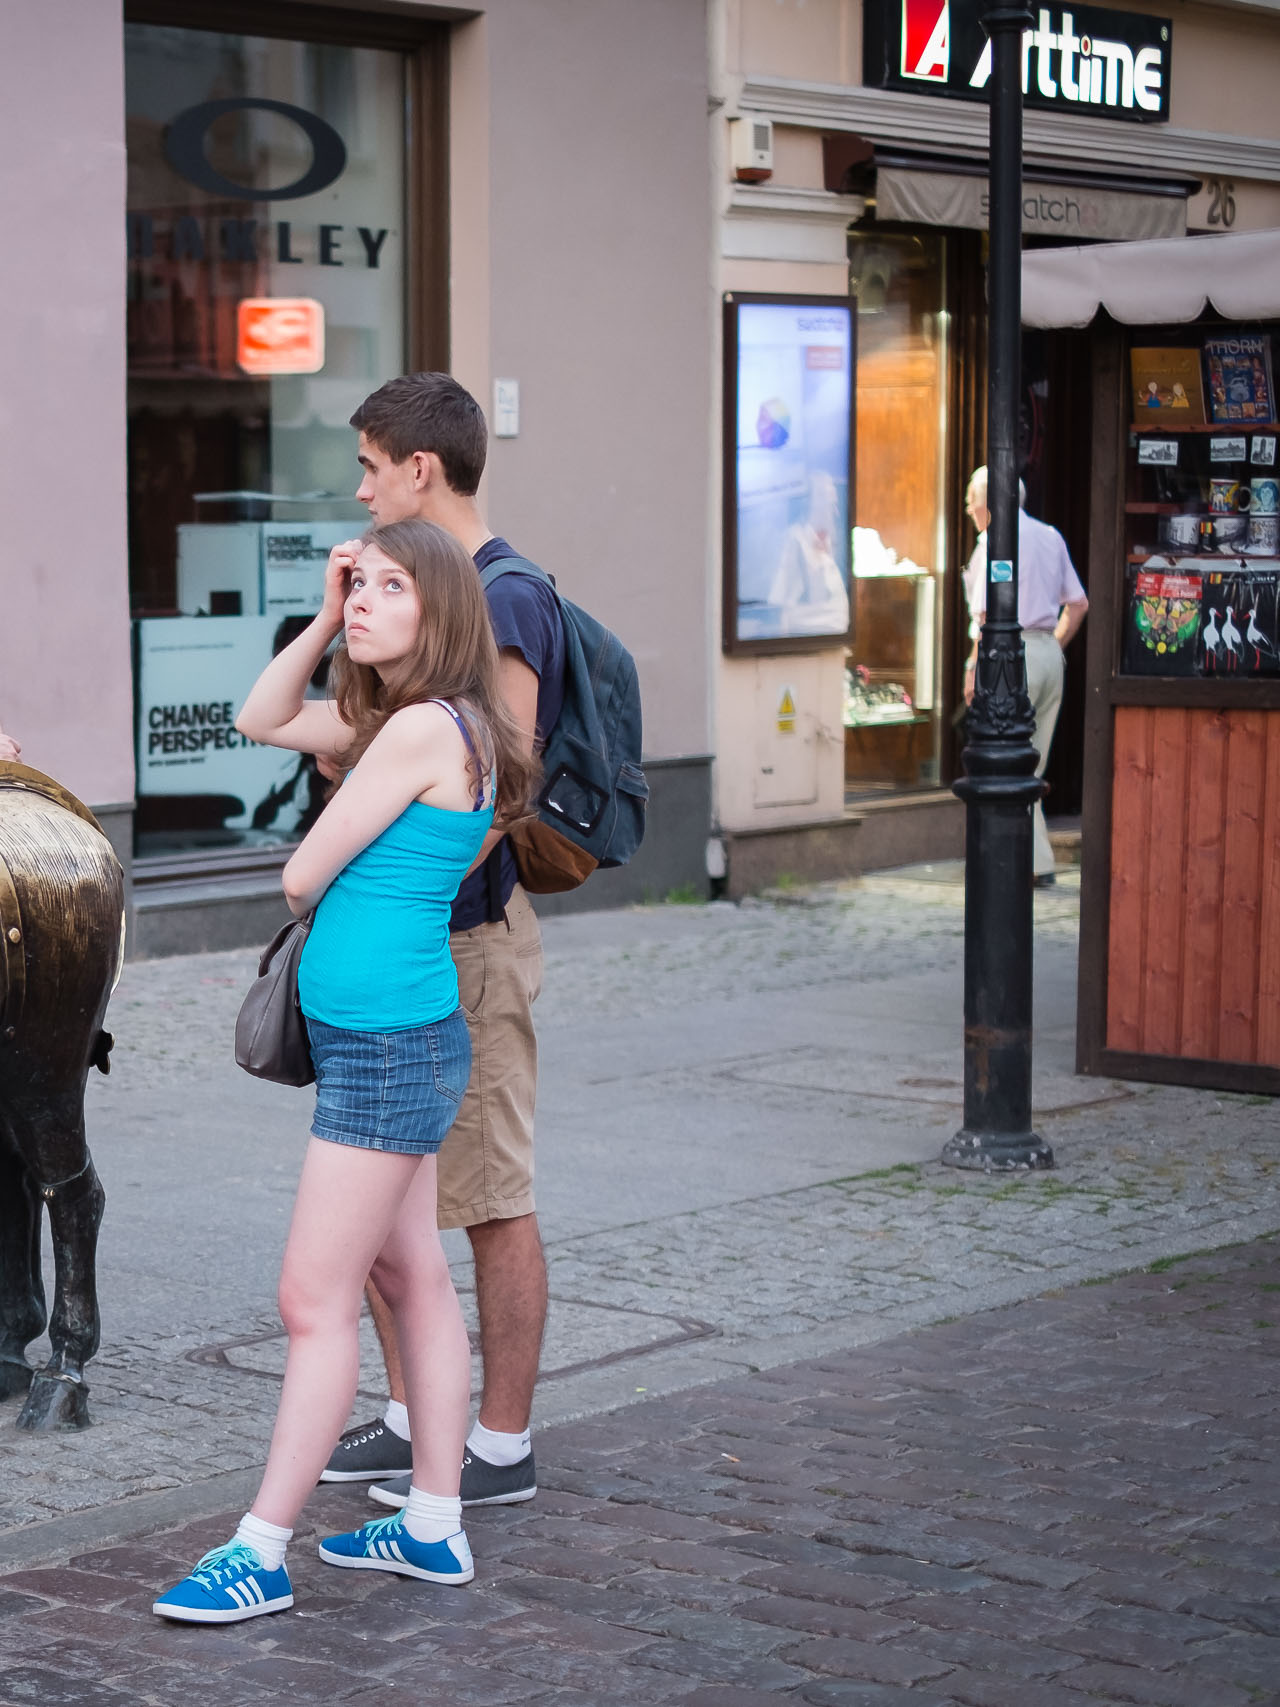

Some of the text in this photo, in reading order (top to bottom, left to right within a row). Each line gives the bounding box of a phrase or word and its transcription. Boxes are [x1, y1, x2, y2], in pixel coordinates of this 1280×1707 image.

[980, 193, 1081, 224] satch
[1207, 179, 1236, 227] 26
[149, 701, 233, 729] CHANGE
[148, 727, 267, 755] PERSPEC
